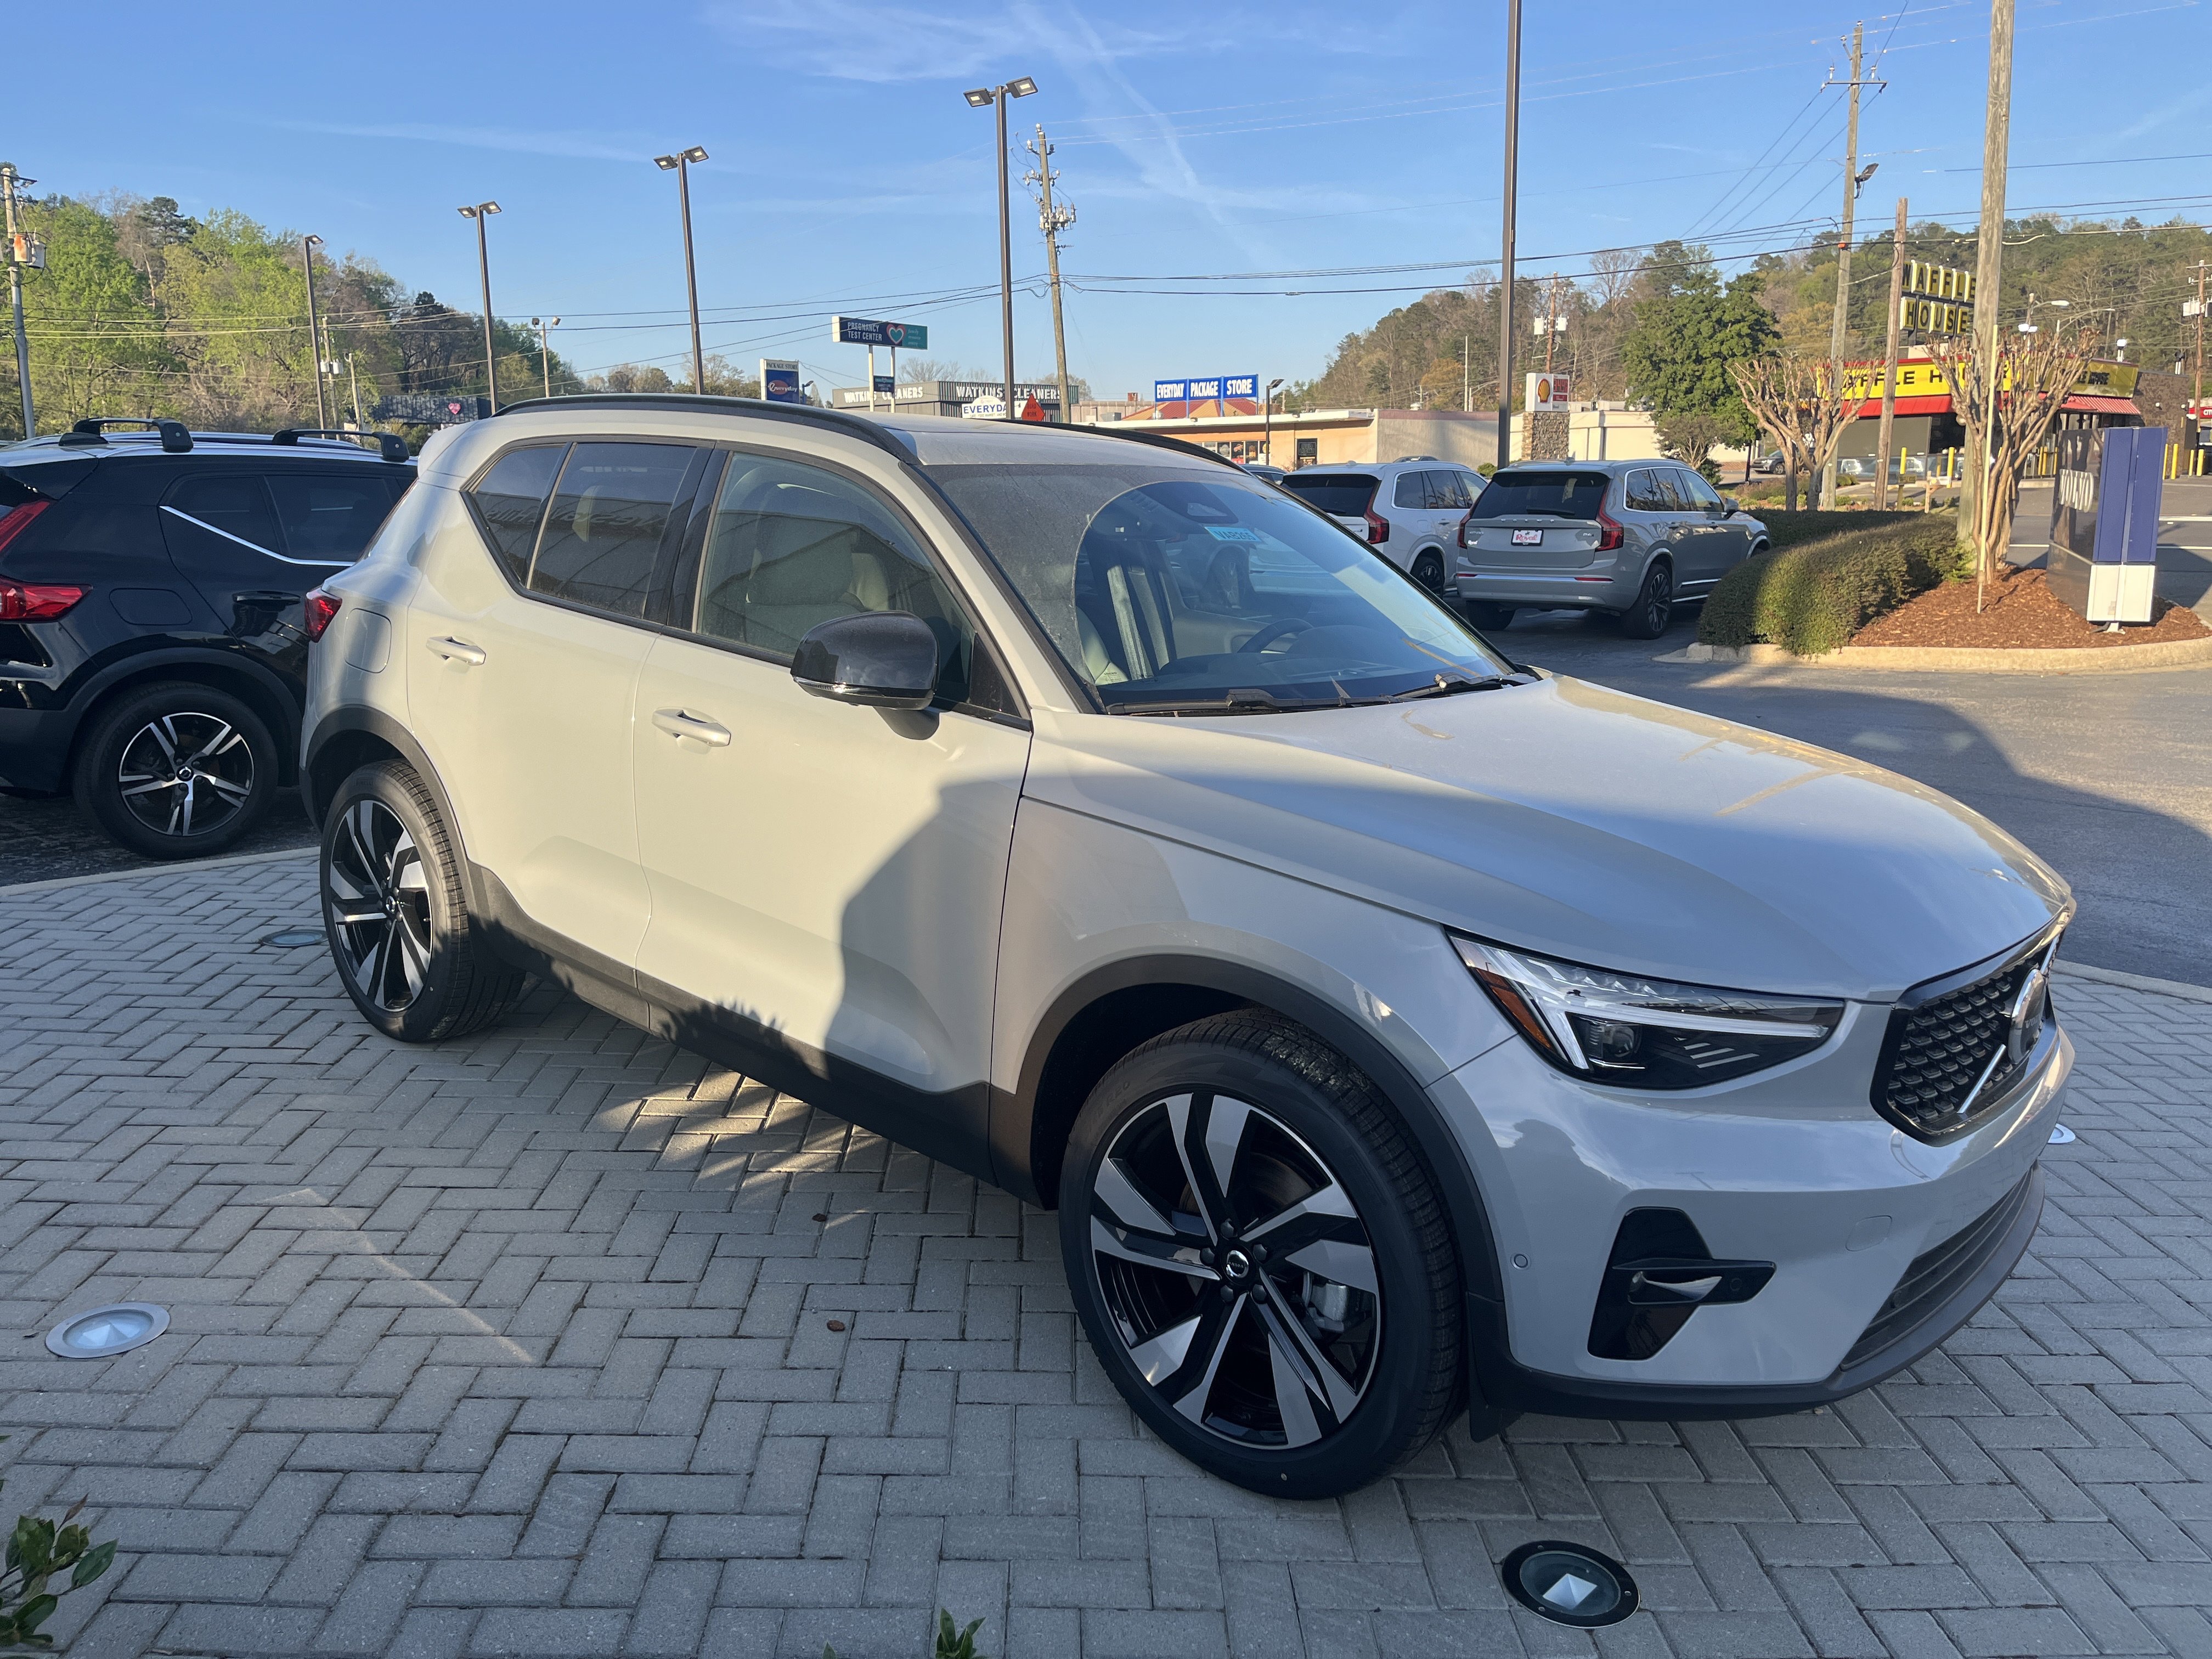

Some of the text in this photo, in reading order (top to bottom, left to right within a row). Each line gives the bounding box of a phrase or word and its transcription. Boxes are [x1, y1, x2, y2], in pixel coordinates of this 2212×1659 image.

[1903, 263, 1976, 298] WAFFLE
[1907, 302, 1968, 332] HOUSE
[847, 322, 879, 332] PREGNANCY
[848, 330, 883, 341] TEST CENTER
[956, 386, 1003, 398] WATKINS
[1156, 379, 1252, 399] EVERYDAY PACKAGE STORE
[963, 404, 1006, 414] EVERYDA
[1516, 533, 1538, 542] Royal
